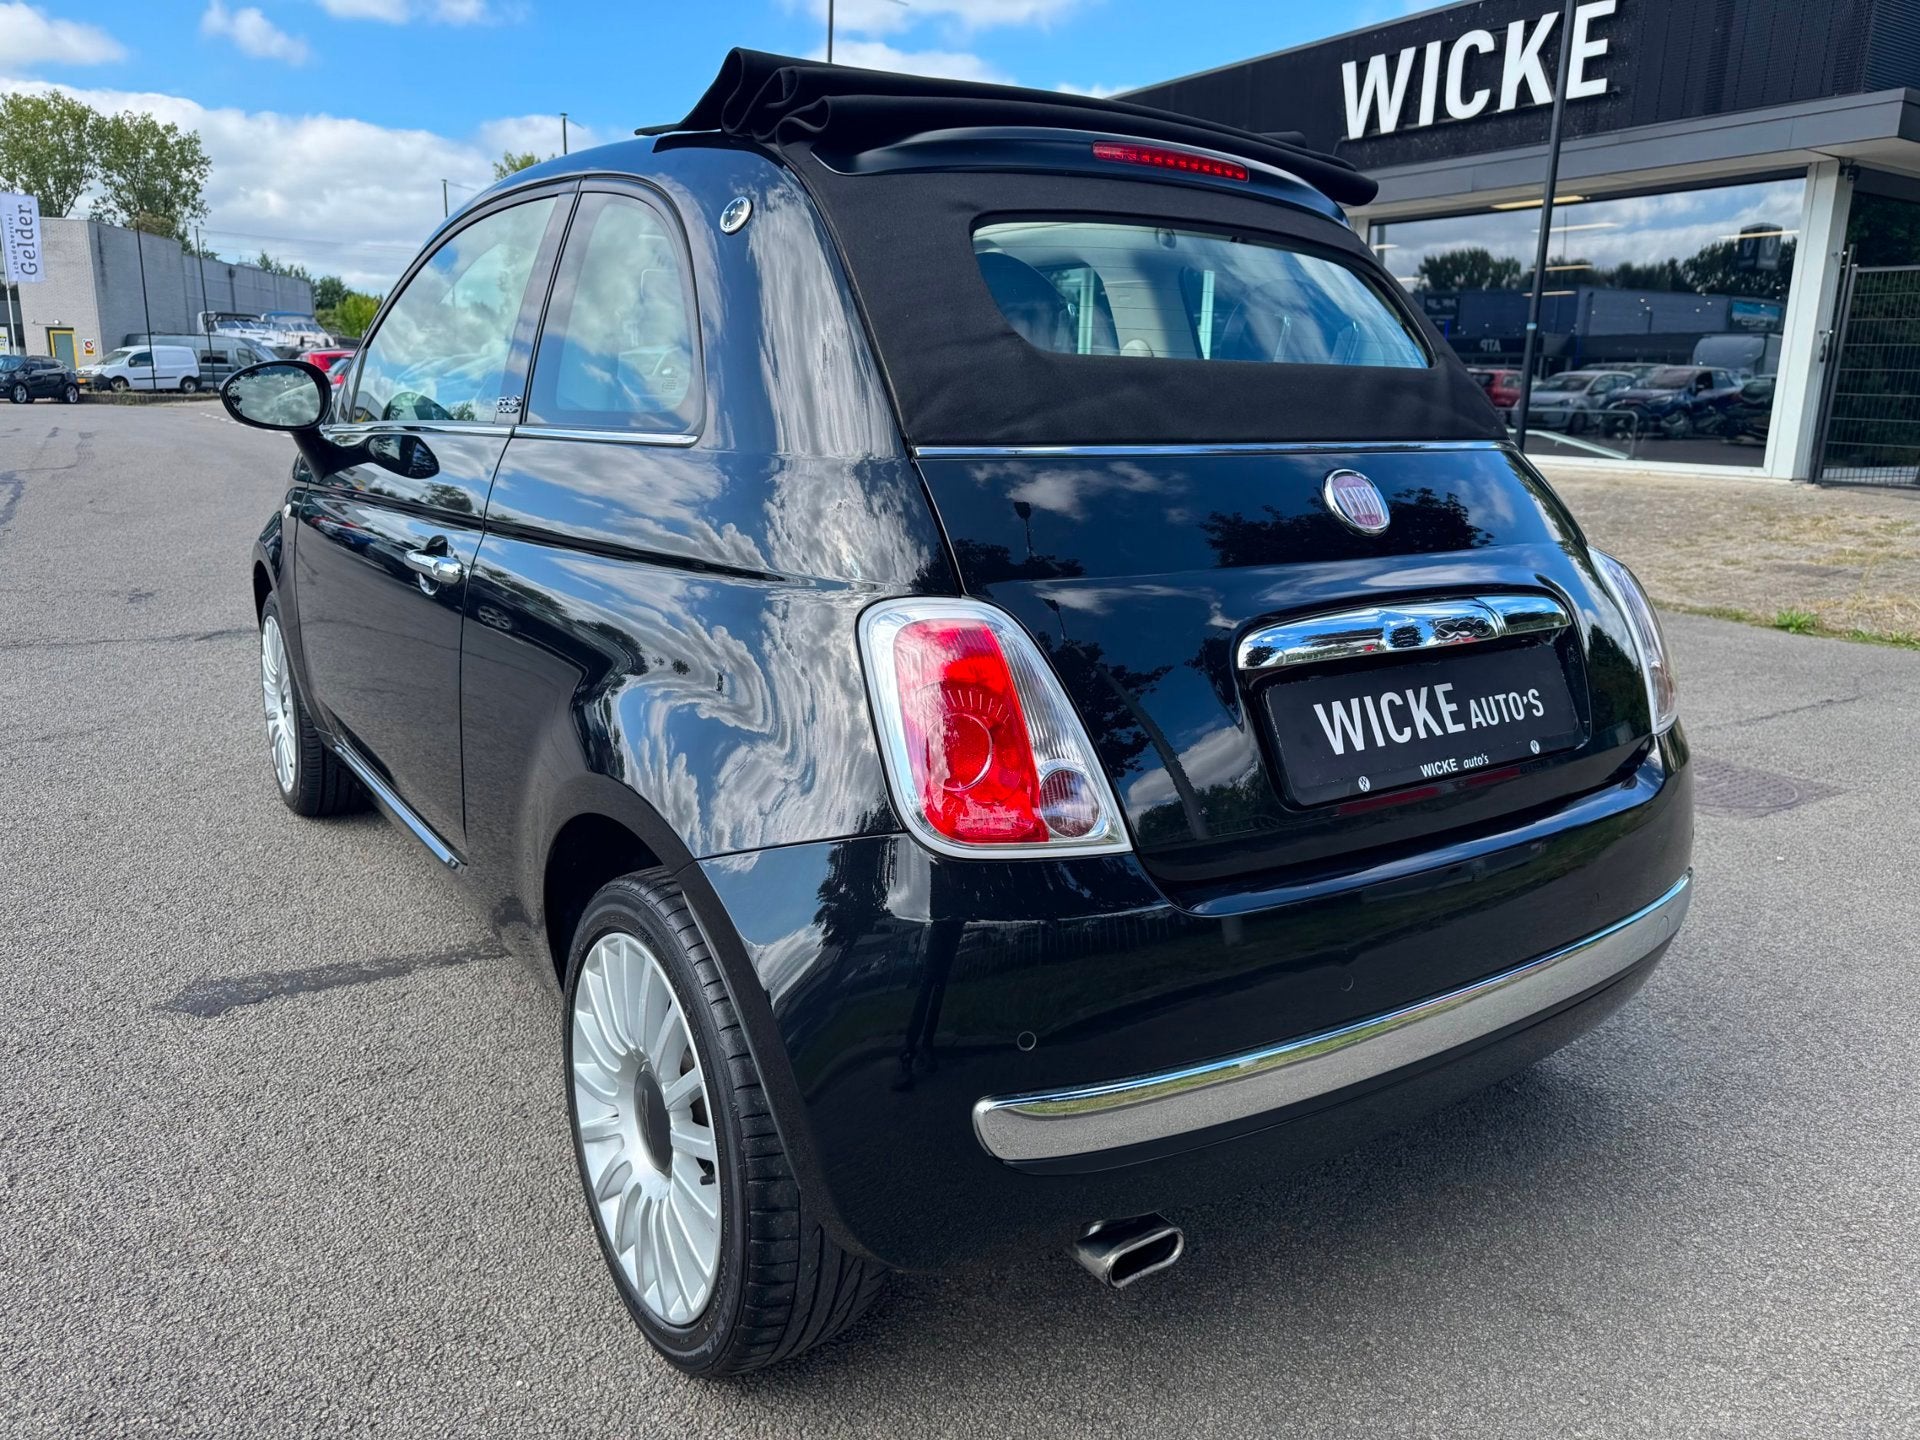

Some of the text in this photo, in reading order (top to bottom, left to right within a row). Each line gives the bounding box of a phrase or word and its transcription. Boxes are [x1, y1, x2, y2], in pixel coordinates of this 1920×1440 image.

[1342, 0, 1617, 140] WICKE
[15, 204, 38, 276] Gelder
[1313, 683, 1545, 755] WICKE AUTO'S
[1420, 753, 1489, 777] WICKE auto's
